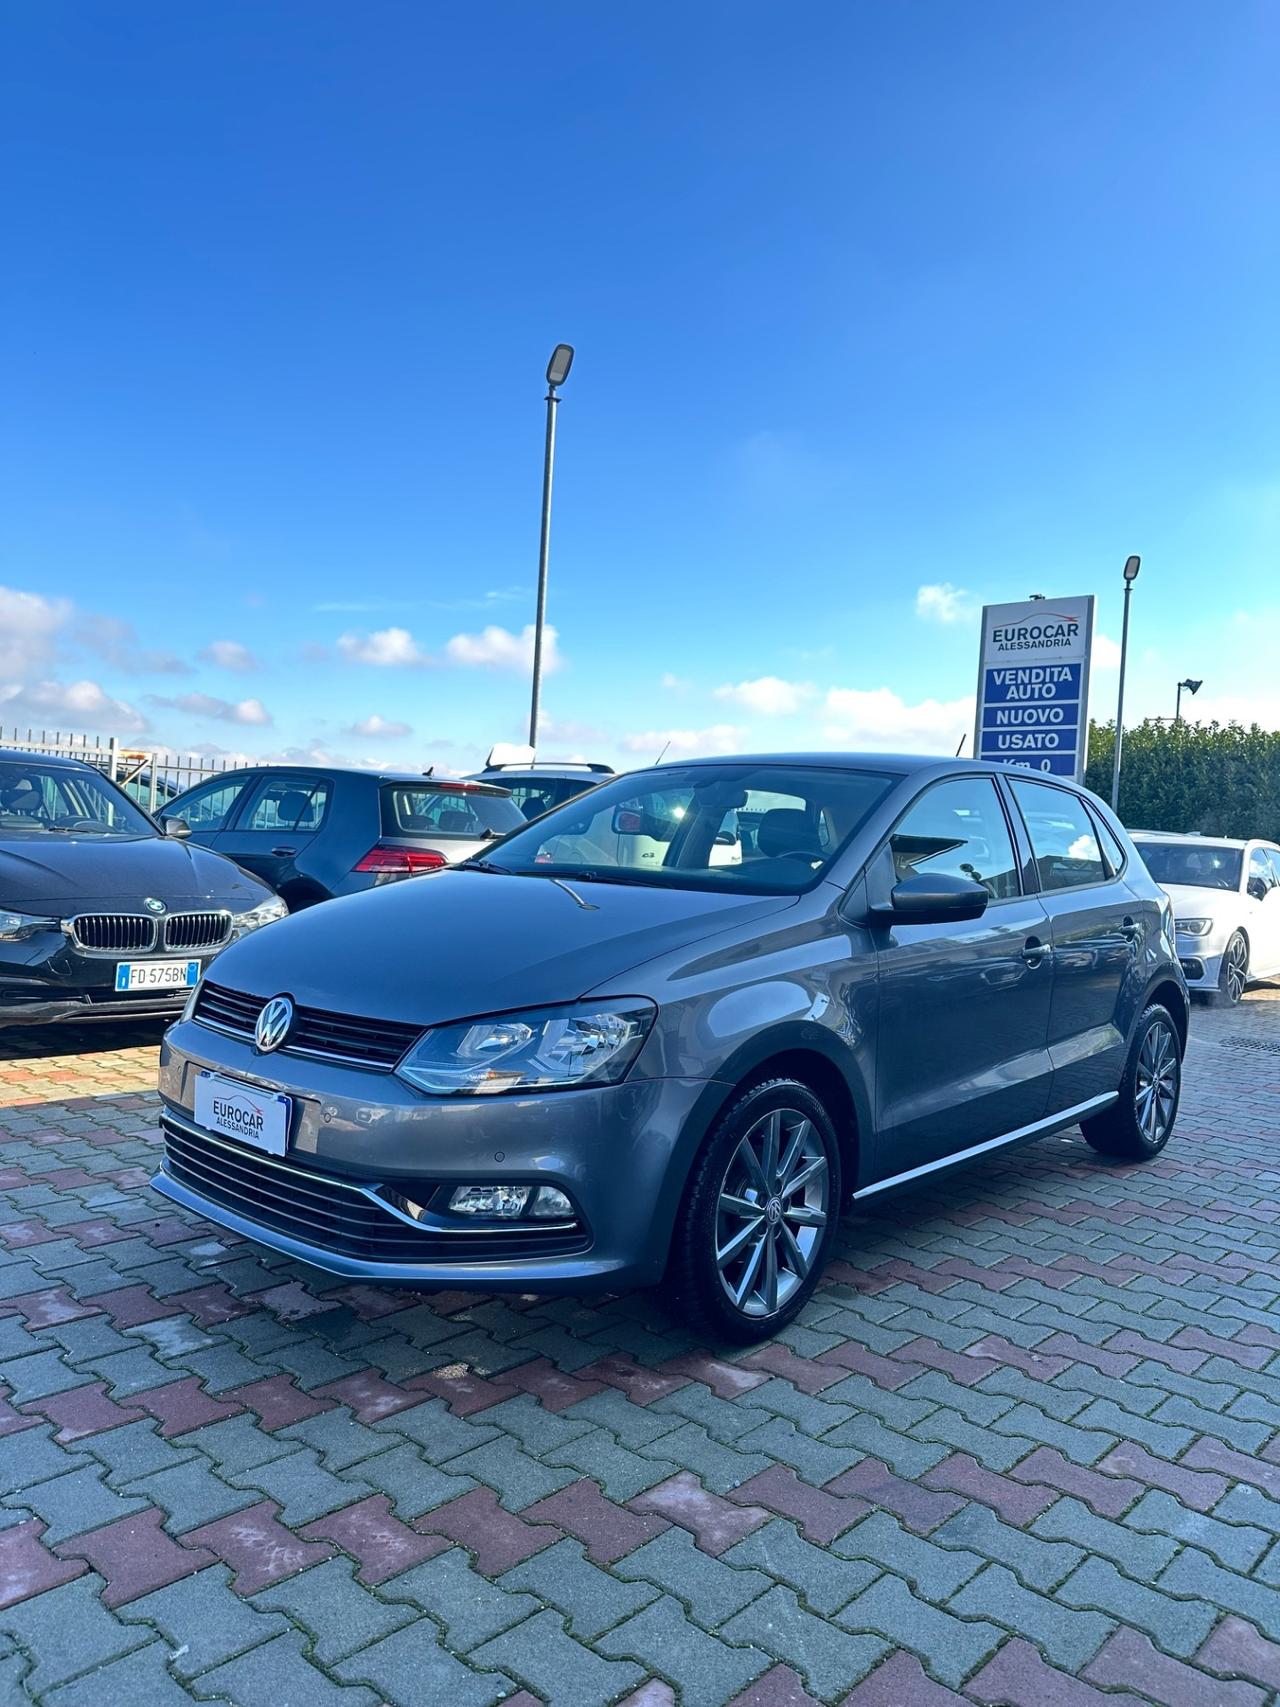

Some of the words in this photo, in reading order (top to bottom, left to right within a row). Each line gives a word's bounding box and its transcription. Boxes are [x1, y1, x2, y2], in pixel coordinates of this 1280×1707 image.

[993, 623, 1079, 643] EUROCAR
[998, 638, 1072, 651] ALESSANDRIA
[993, 667, 1073, 685] VENDITA
[1006, 683, 1056, 700] AUTO
[996, 708, 1064, 725] NUOVO
[998, 733, 1059, 749] USATO
[130, 969, 146, 984] FD
[149, 967, 187, 983] 575BN
[213, 1099, 264, 1131] EUROCAR
[216, 1117, 260, 1139] ALESSANDRIA
